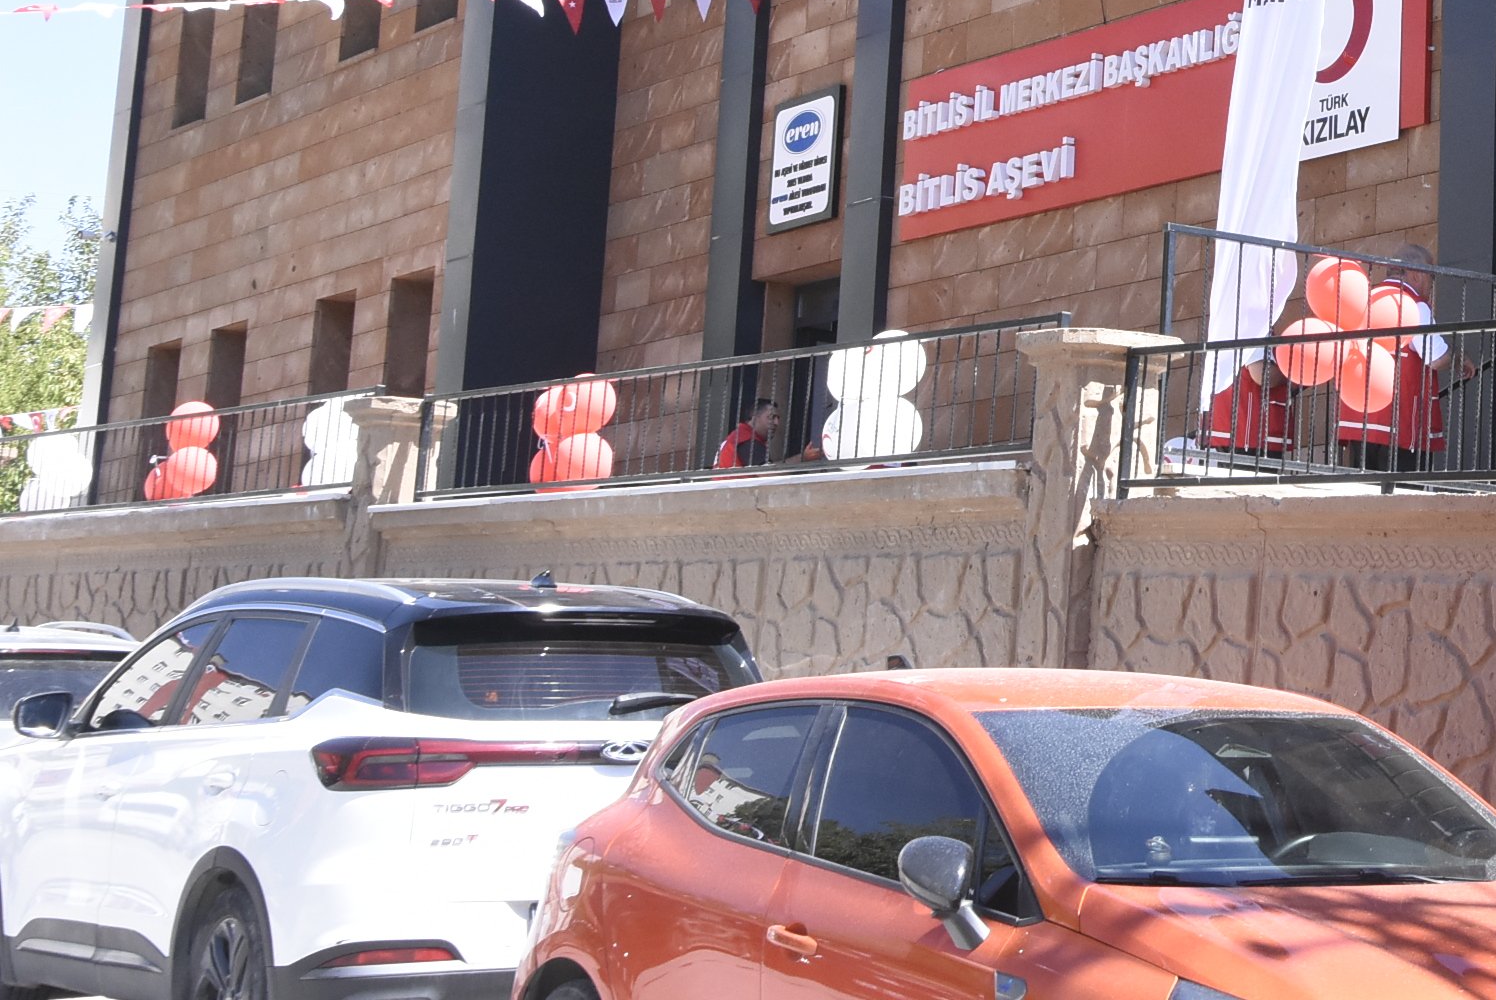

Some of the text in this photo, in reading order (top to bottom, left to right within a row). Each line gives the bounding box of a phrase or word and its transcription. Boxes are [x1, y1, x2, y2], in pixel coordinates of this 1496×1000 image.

[903, 12, 1243, 141] BİTLİS İL MERKEZİ BAŞKANLIĞ
[1319, 92, 1349, 113] TÜRK
[786, 120, 819, 143] eren
[898, 136, 1076, 216] BİTLİS AŞEVİ
